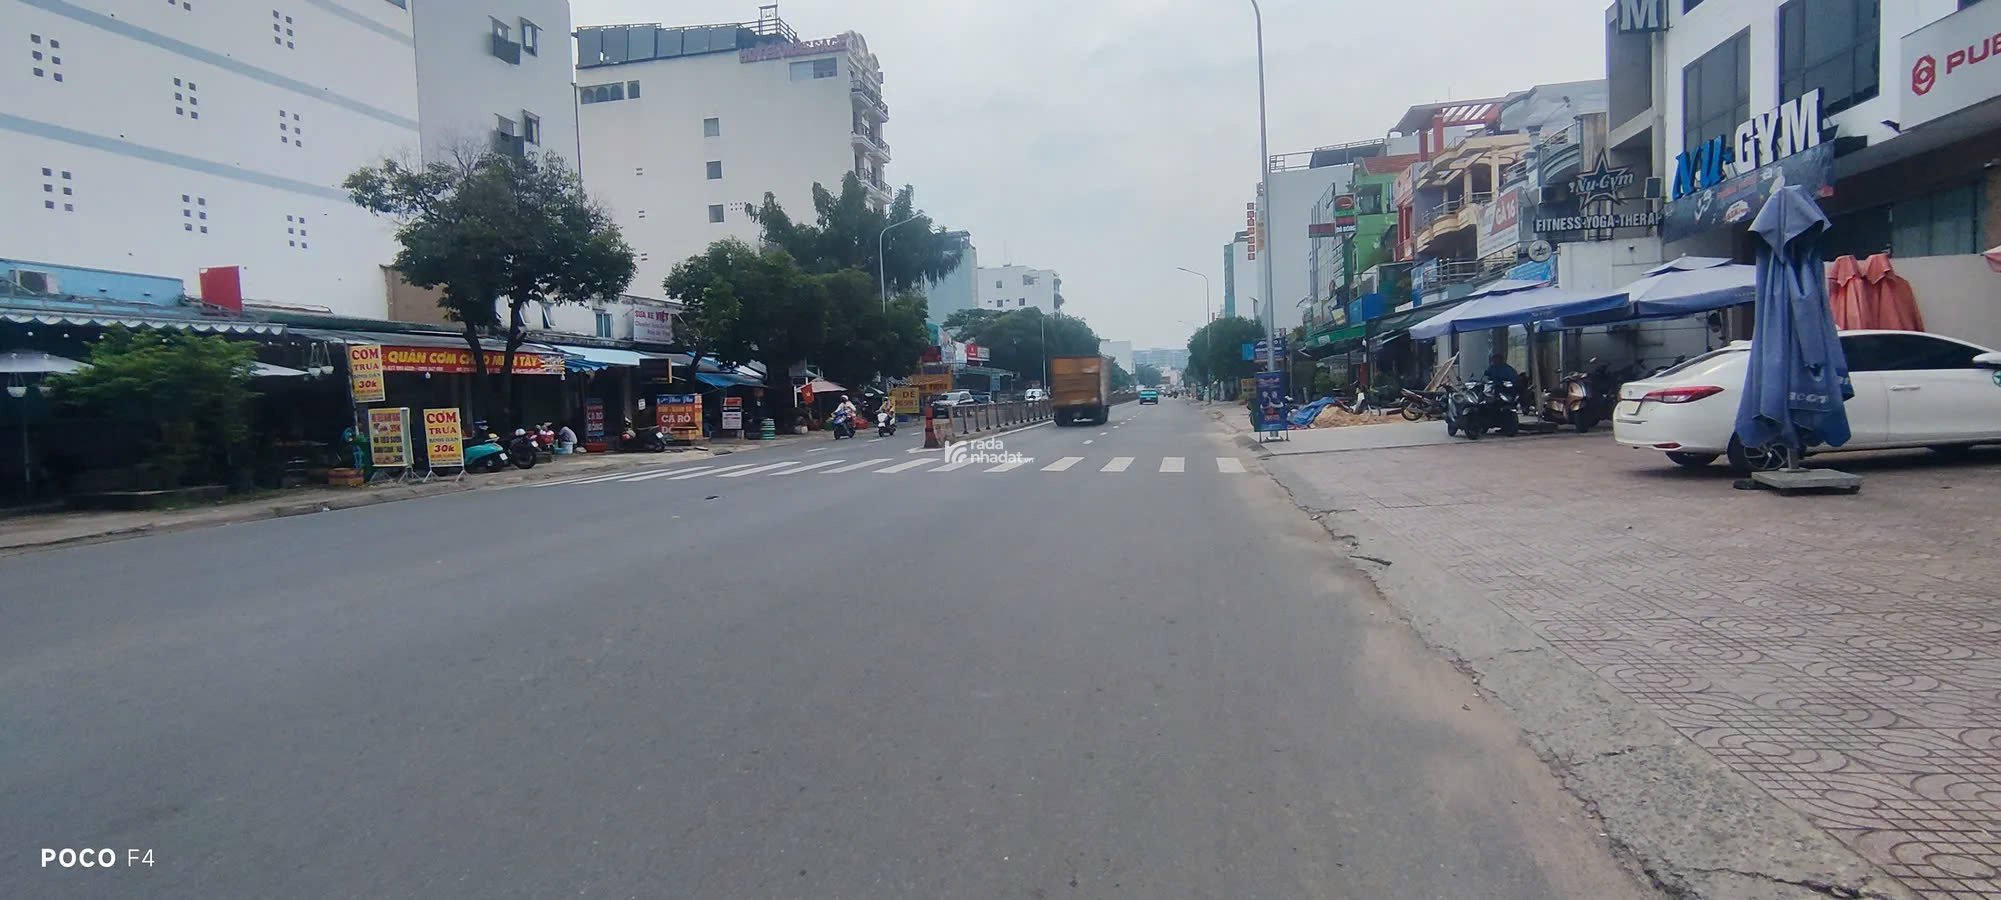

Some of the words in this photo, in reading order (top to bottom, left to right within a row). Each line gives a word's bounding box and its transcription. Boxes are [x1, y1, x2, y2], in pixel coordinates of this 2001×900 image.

[429, 351, 457, 364] CƠM
[661, 412, 676, 423] CÁ
[677, 412, 691, 423] RÔ
